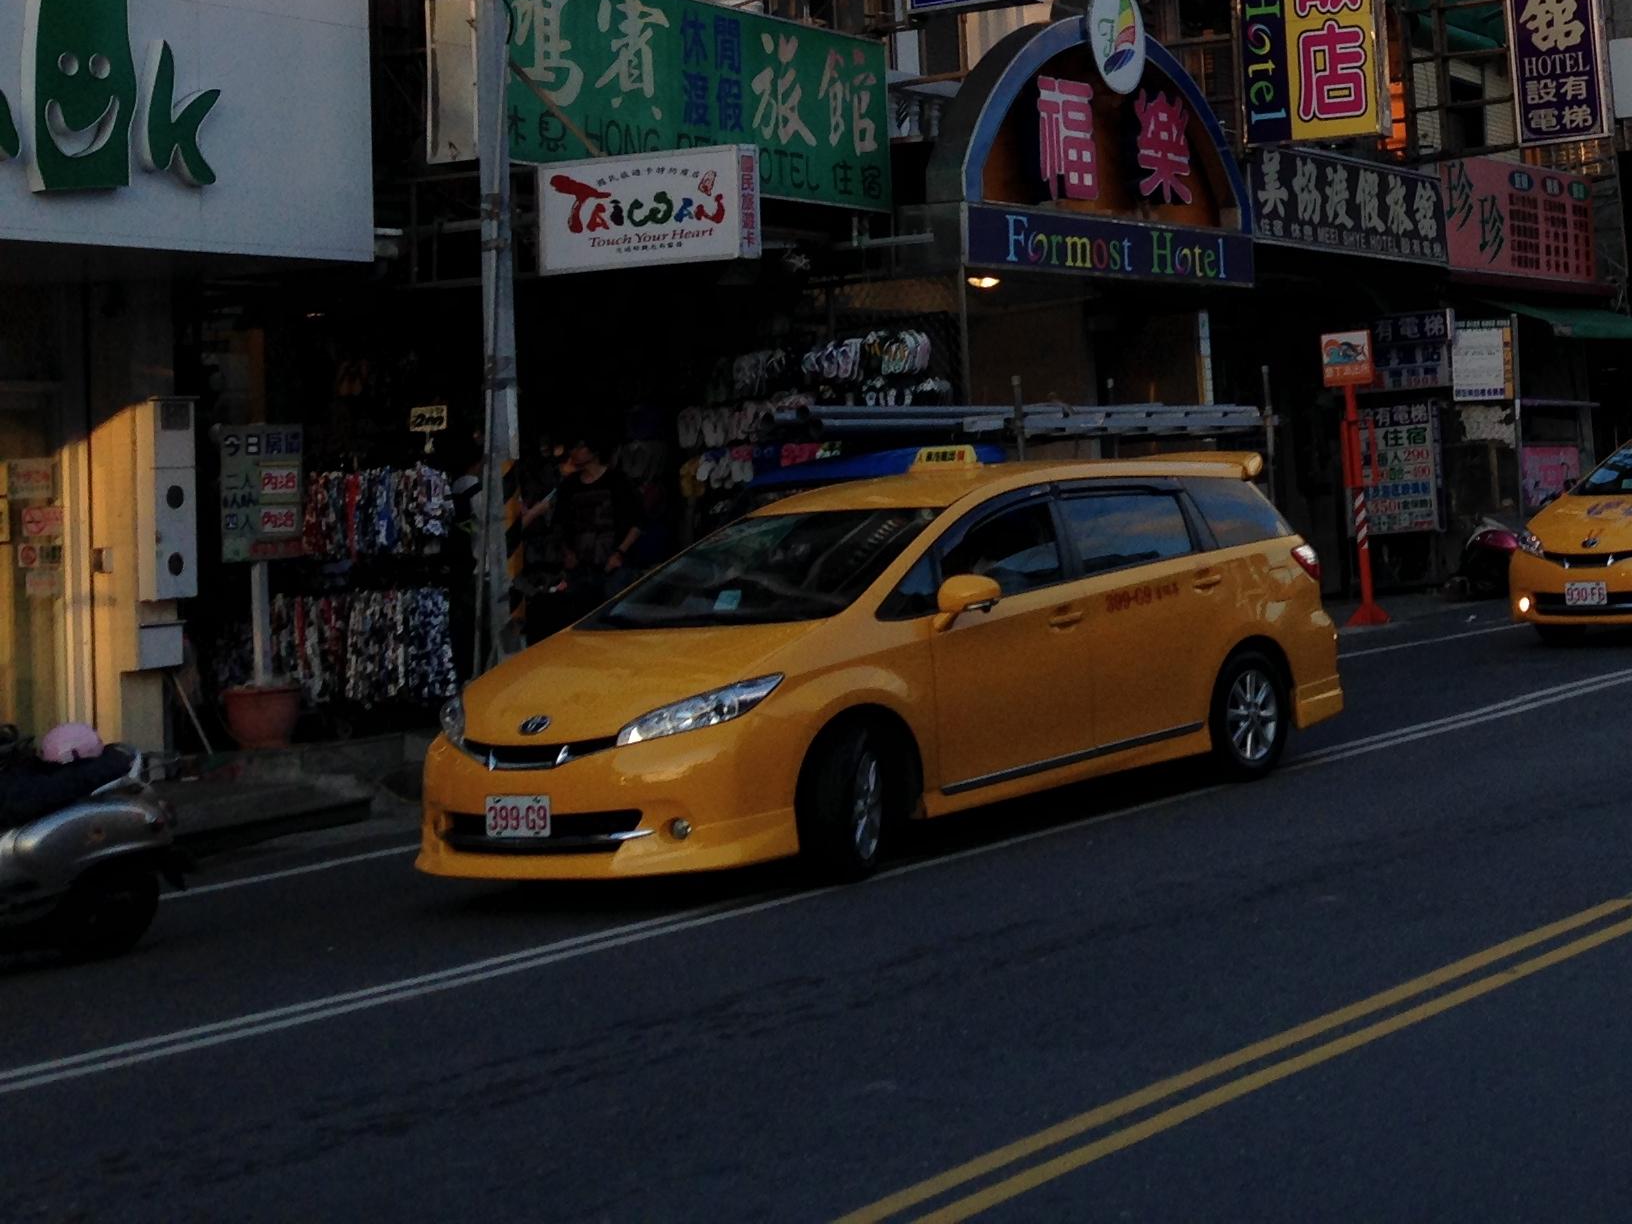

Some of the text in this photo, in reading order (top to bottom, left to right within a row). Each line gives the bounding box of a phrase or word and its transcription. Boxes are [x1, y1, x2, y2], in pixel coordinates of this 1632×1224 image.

[1524, 52, 1591, 76] HOTEL
[750, 32, 881, 157] 旅館
[760, 147, 820, 194] OTEL
[832, 160, 883, 201] 住宿
[590, 226, 715, 248] Touch Your Heart
[1005, 214, 1228, 279] Formost Hotel
[487, 805, 547, 830] 399-G9
